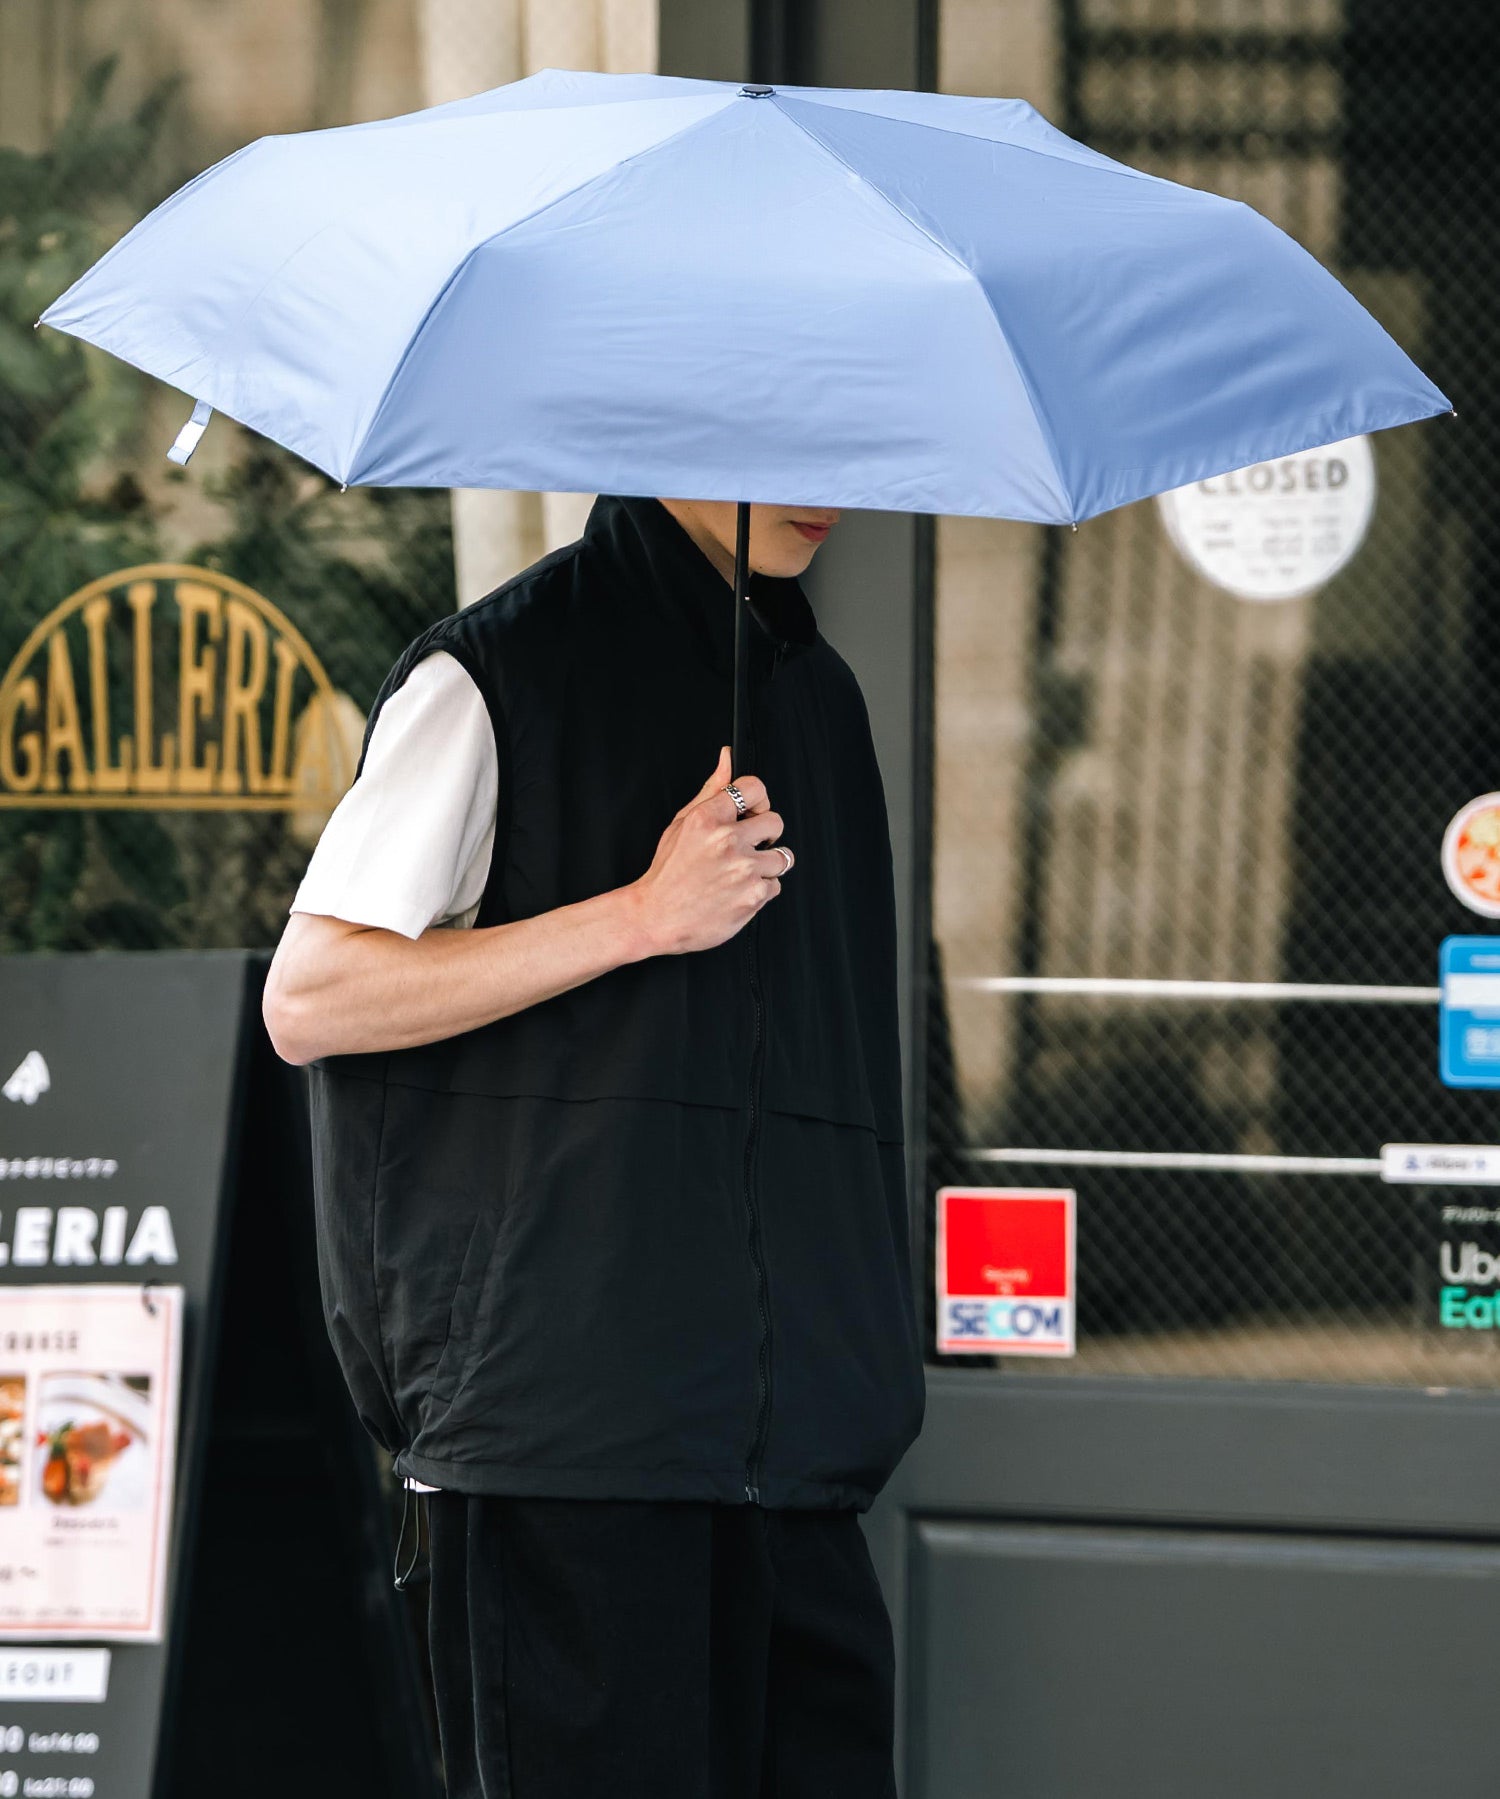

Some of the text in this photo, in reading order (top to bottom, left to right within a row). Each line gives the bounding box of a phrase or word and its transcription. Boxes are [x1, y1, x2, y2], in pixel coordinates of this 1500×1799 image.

[0, 1206, 178, 1267] ERIA
[1440, 1241, 1500, 1285] Ub
[951, 1303, 1062, 1336] SECOM
